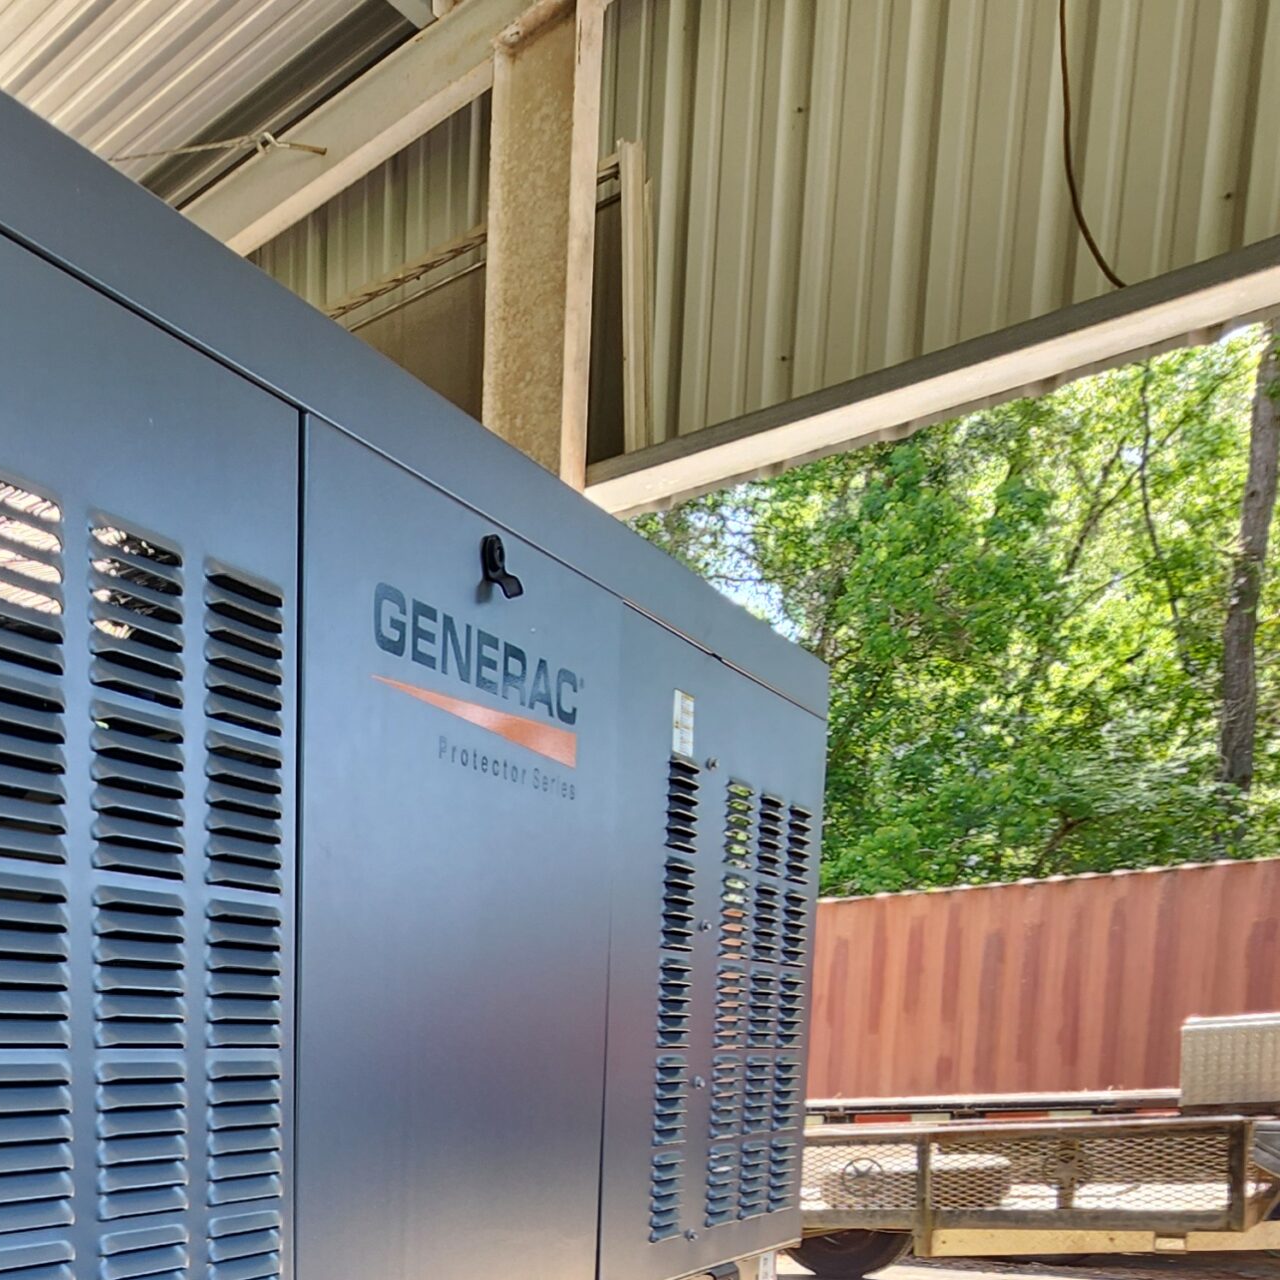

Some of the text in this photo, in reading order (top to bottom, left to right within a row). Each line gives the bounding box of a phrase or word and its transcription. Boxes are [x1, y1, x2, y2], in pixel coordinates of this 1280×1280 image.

[374, 582, 578, 725] GENERAC
[438, 735, 576, 800] Protector Series
